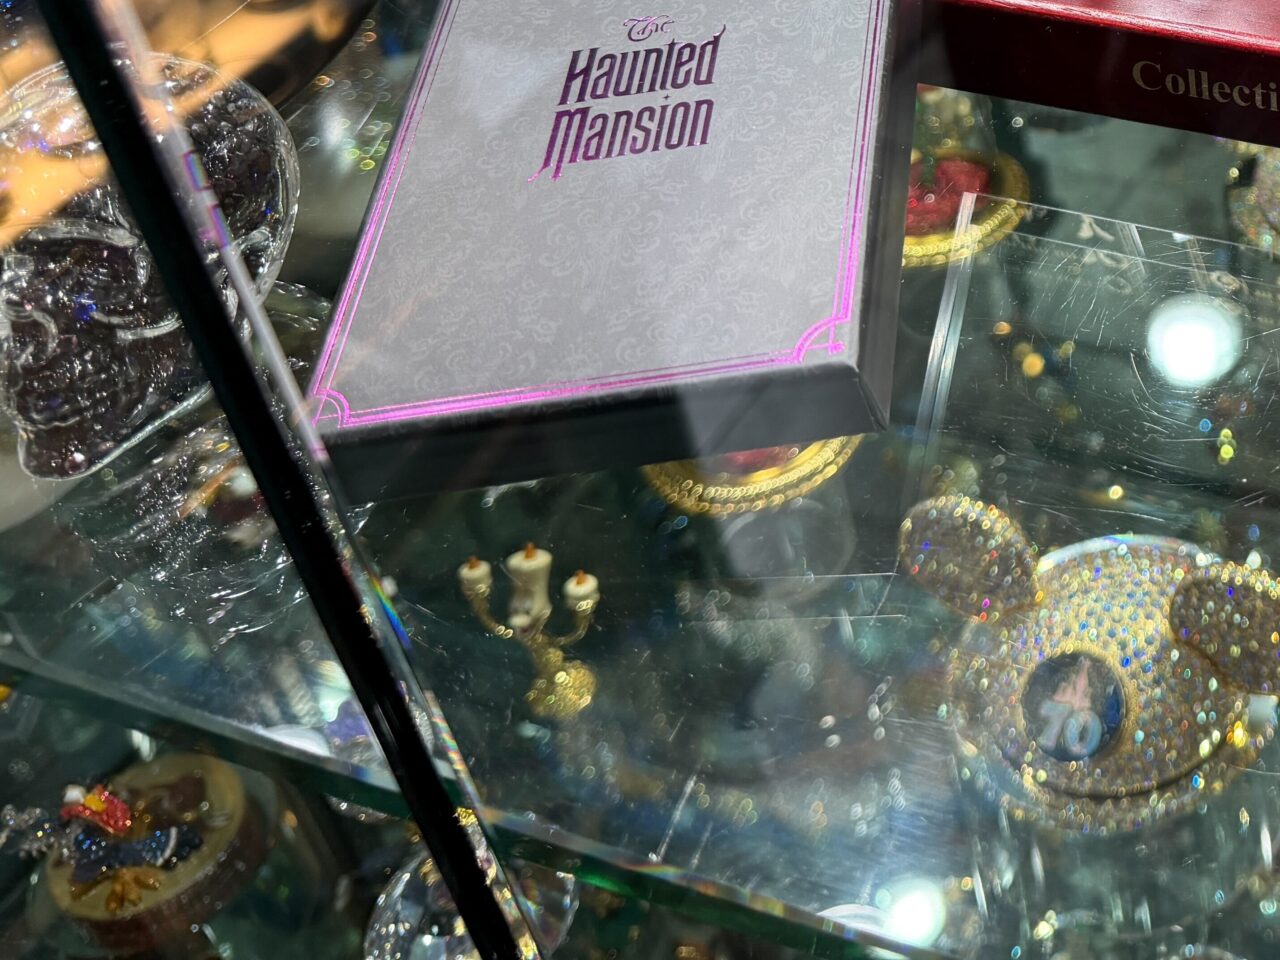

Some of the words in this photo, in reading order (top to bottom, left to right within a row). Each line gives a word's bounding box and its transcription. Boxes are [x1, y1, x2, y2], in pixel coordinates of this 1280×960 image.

[557, 24, 726, 106] Haunted
[622, 14, 675, 42] The
[527, 93, 714, 182] Mansion
